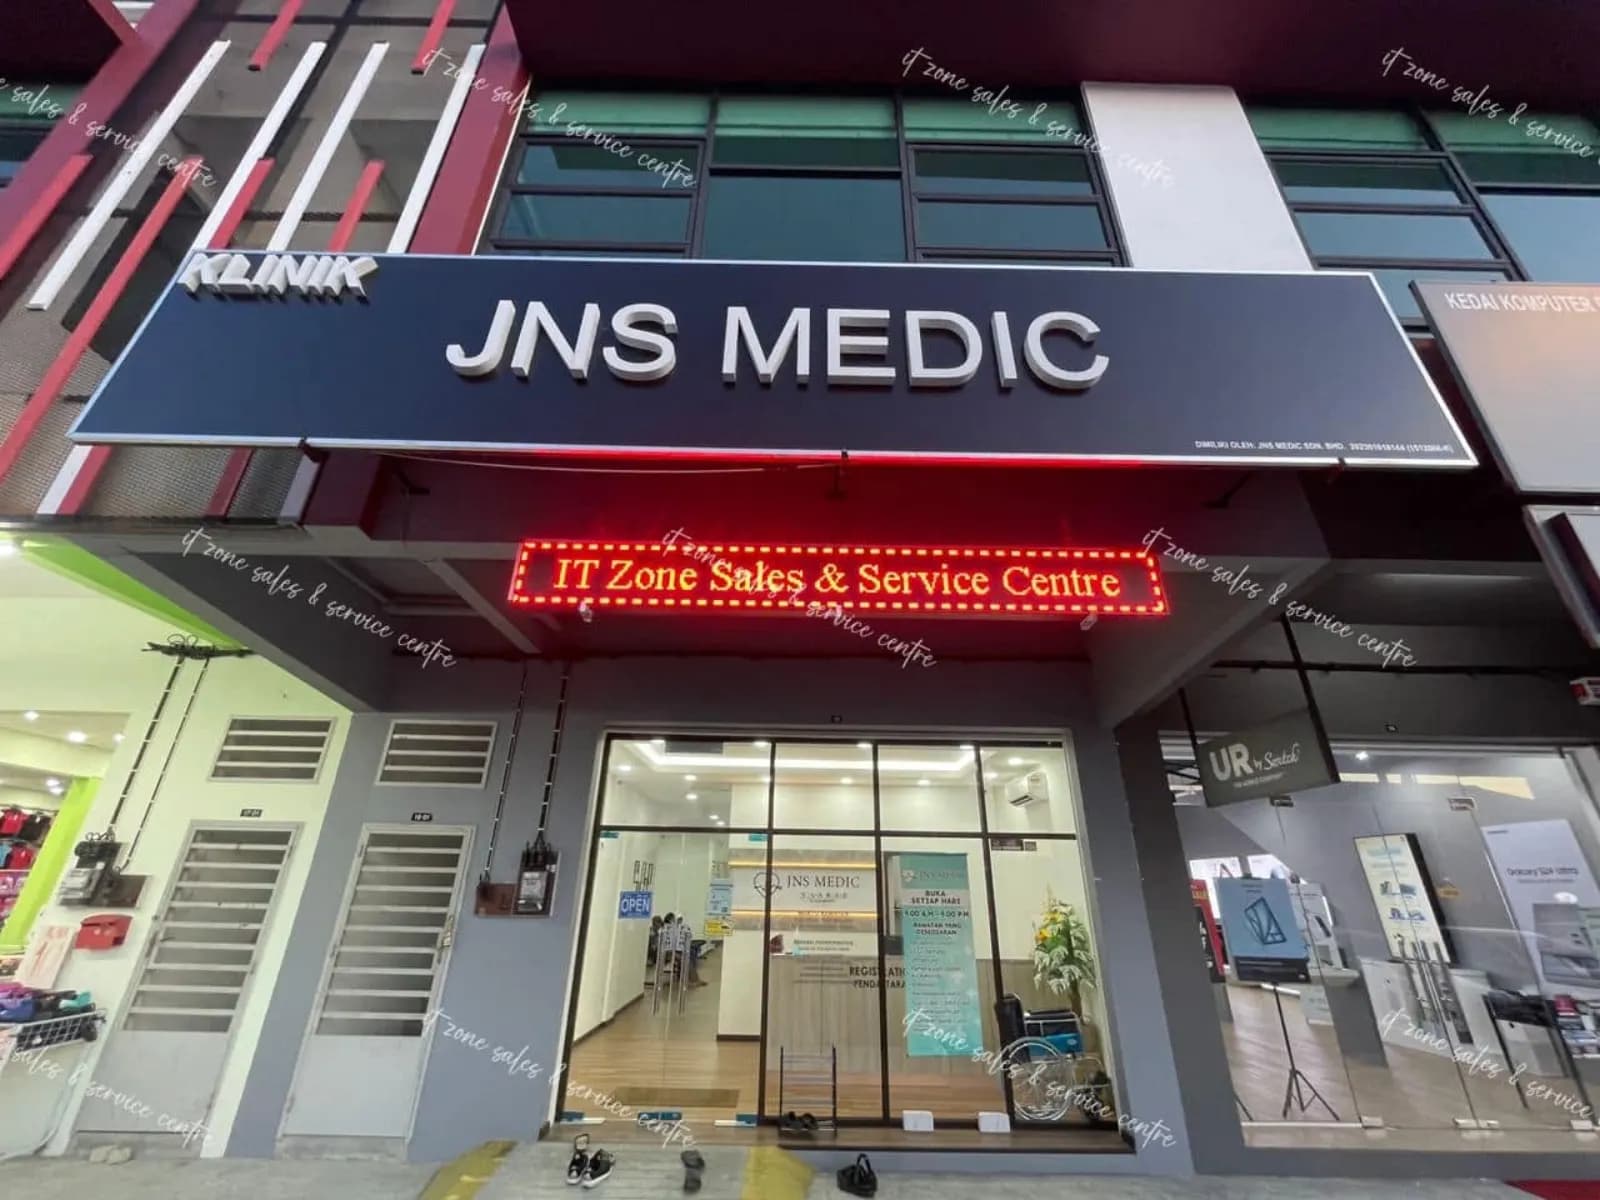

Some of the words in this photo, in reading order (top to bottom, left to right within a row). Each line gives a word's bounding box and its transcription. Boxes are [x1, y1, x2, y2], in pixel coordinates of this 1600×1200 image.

[178, 252, 378, 298] KLINIK
[1444, 292, 1500, 311] KEDAI
[1500, 293, 1591, 313] KOMPUTER
[446, 299, 678, 381] JNS
[722, 305, 1109, 389] MEDIC
[1275, 441, 1302, 450] MEDIC
[554, 559, 599, 589] IT
[606, 559, 698, 591] Zone
[710, 560, 804, 592] Sales
[814, 563, 849, 593] &
[858, 563, 990, 596] Service
[1002, 566, 1121, 597] Centre
[1209, 743, 1254, 781] UR
[786, 874, 810, 889] JNS
[815, 874, 860, 889] MEDIC
[620, 898, 650, 913] OPEN
